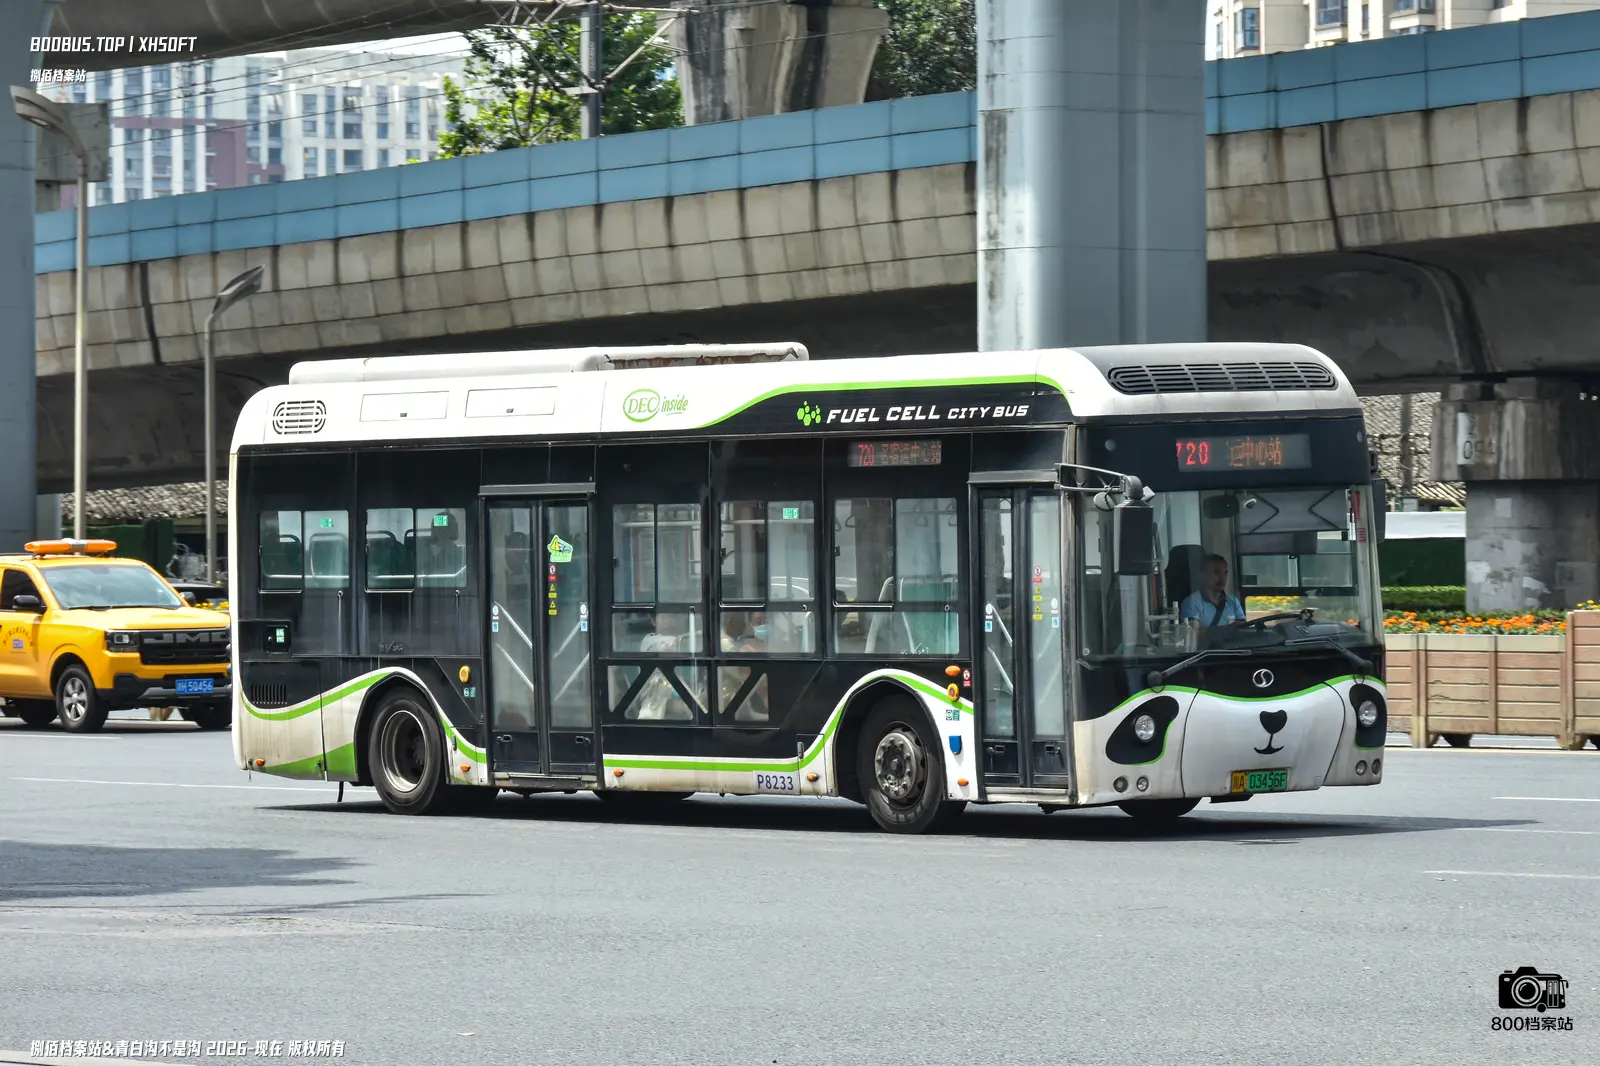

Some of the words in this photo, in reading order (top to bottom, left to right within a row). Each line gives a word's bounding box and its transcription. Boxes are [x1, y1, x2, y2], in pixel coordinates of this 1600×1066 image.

[627, 397, 658, 414] DEC
[661, 394, 689, 413] inside
[826, 407, 880, 424] FUEL
[886, 405, 941, 421] CELL
[947, 407, 991, 420] CITY
[992, 405, 1029, 418] BUS
[1175, 441, 1209, 465] 720
[757, 774, 794, 790] P8233
